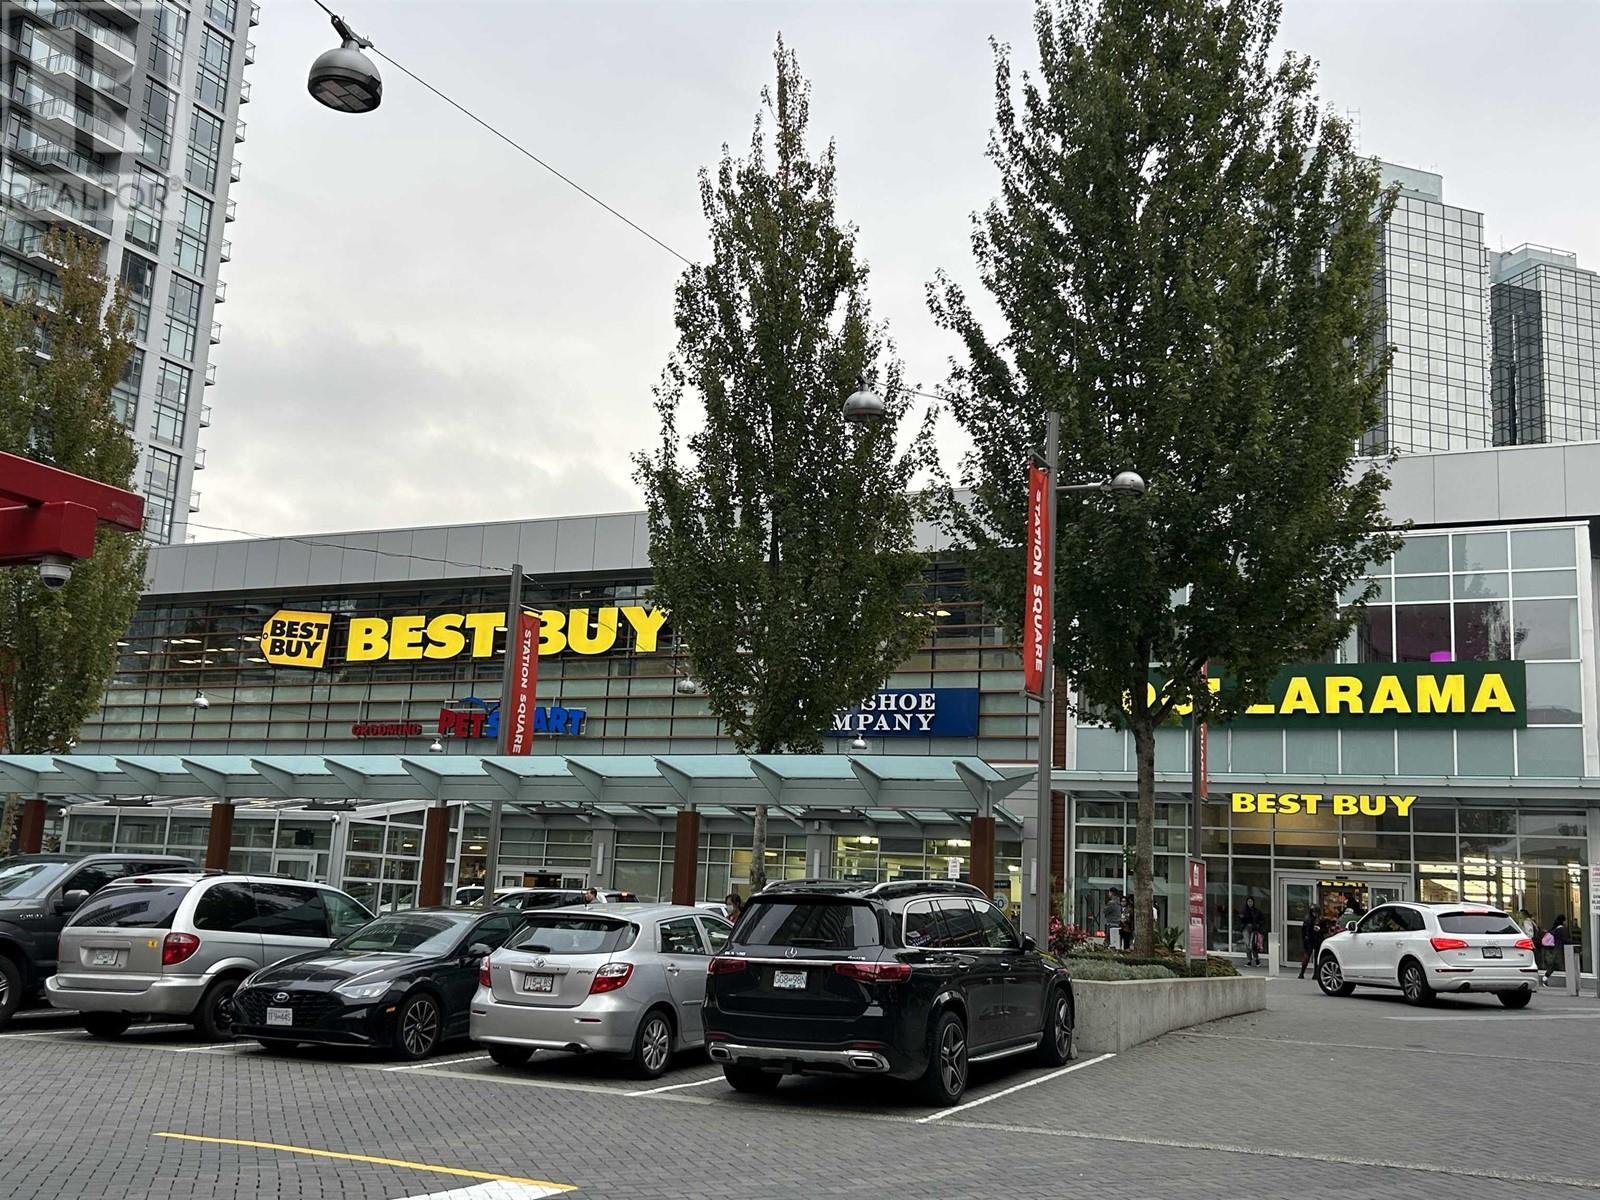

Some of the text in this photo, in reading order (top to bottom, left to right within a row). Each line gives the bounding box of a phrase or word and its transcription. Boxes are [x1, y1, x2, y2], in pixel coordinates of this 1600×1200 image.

[1033, 489, 1044, 673] STATION SQUARE
[270, 619, 329, 641] BEST
[346, 606, 668, 662] BEST BUY
[269, 638, 321, 659] BUY
[512, 629, 532, 754] STATION SQUARE
[861, 693, 936, 711] SHOE
[351, 722, 423, 737] GROOMING
[437, 707, 587, 738] PETSART
[1232, 793, 1418, 817] BEST BUY
